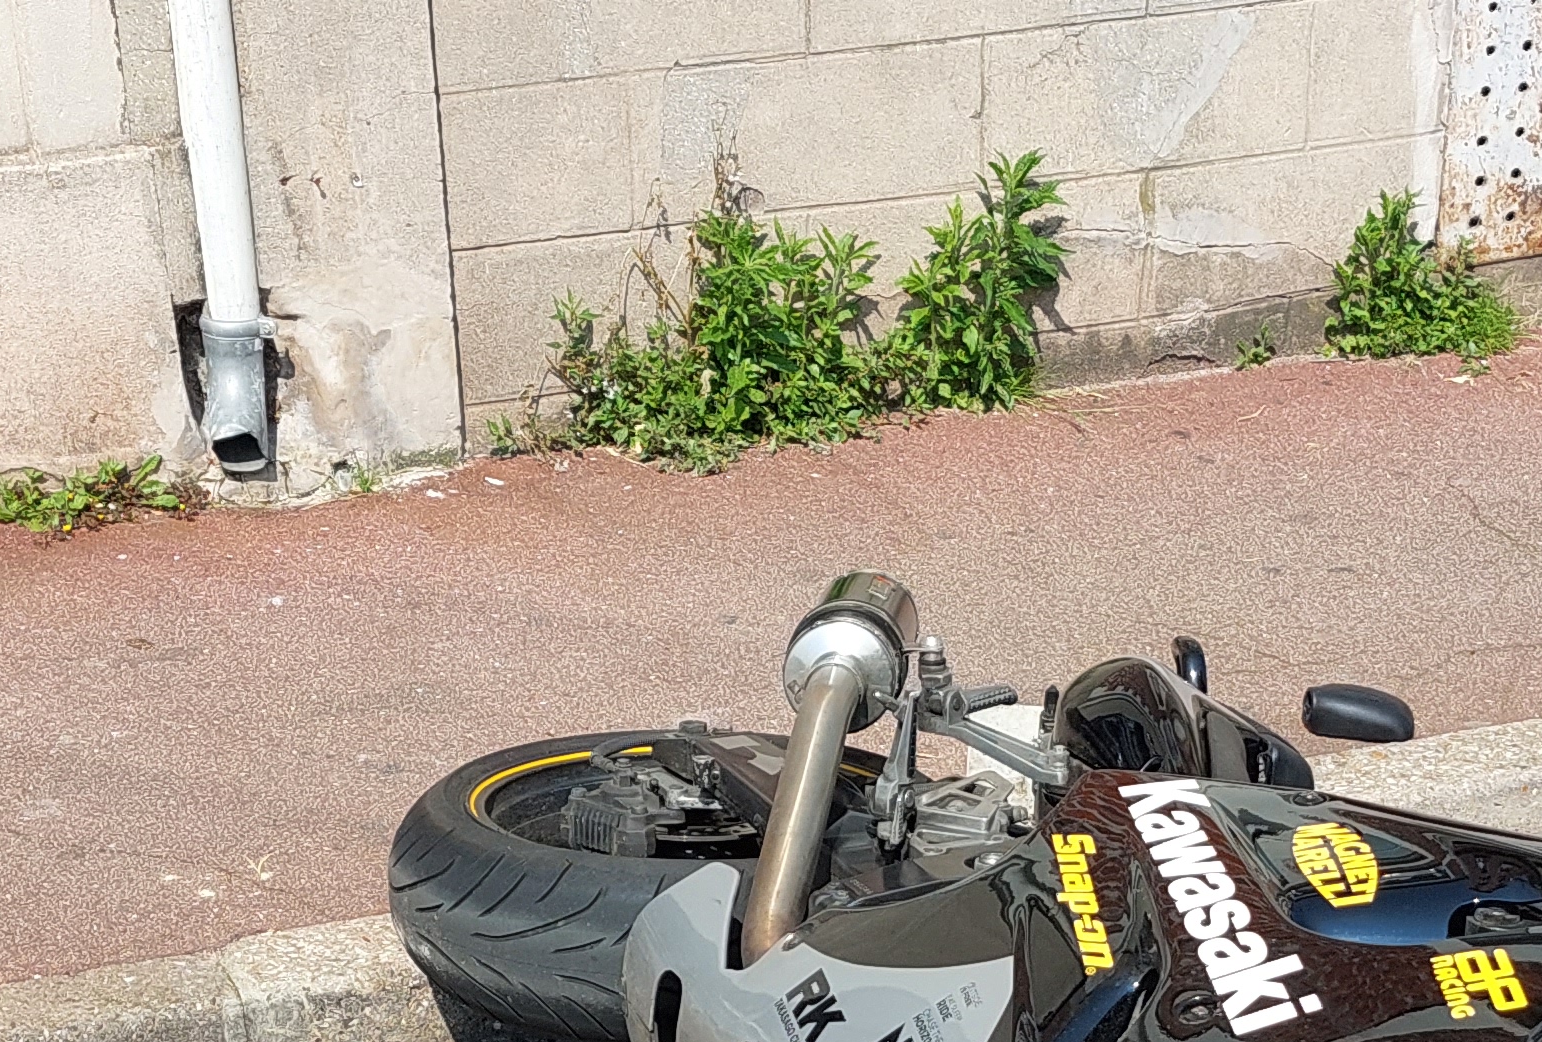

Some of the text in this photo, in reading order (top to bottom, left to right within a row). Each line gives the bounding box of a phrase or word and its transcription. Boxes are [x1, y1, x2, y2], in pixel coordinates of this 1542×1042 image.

[1292, 822, 1357, 908] MARELLI
[1315, 822, 1378, 907] MAGNETI
[1117, 779, 1324, 1036] Kawasaki
[774, 998, 796, 1036] TAKASAGO
